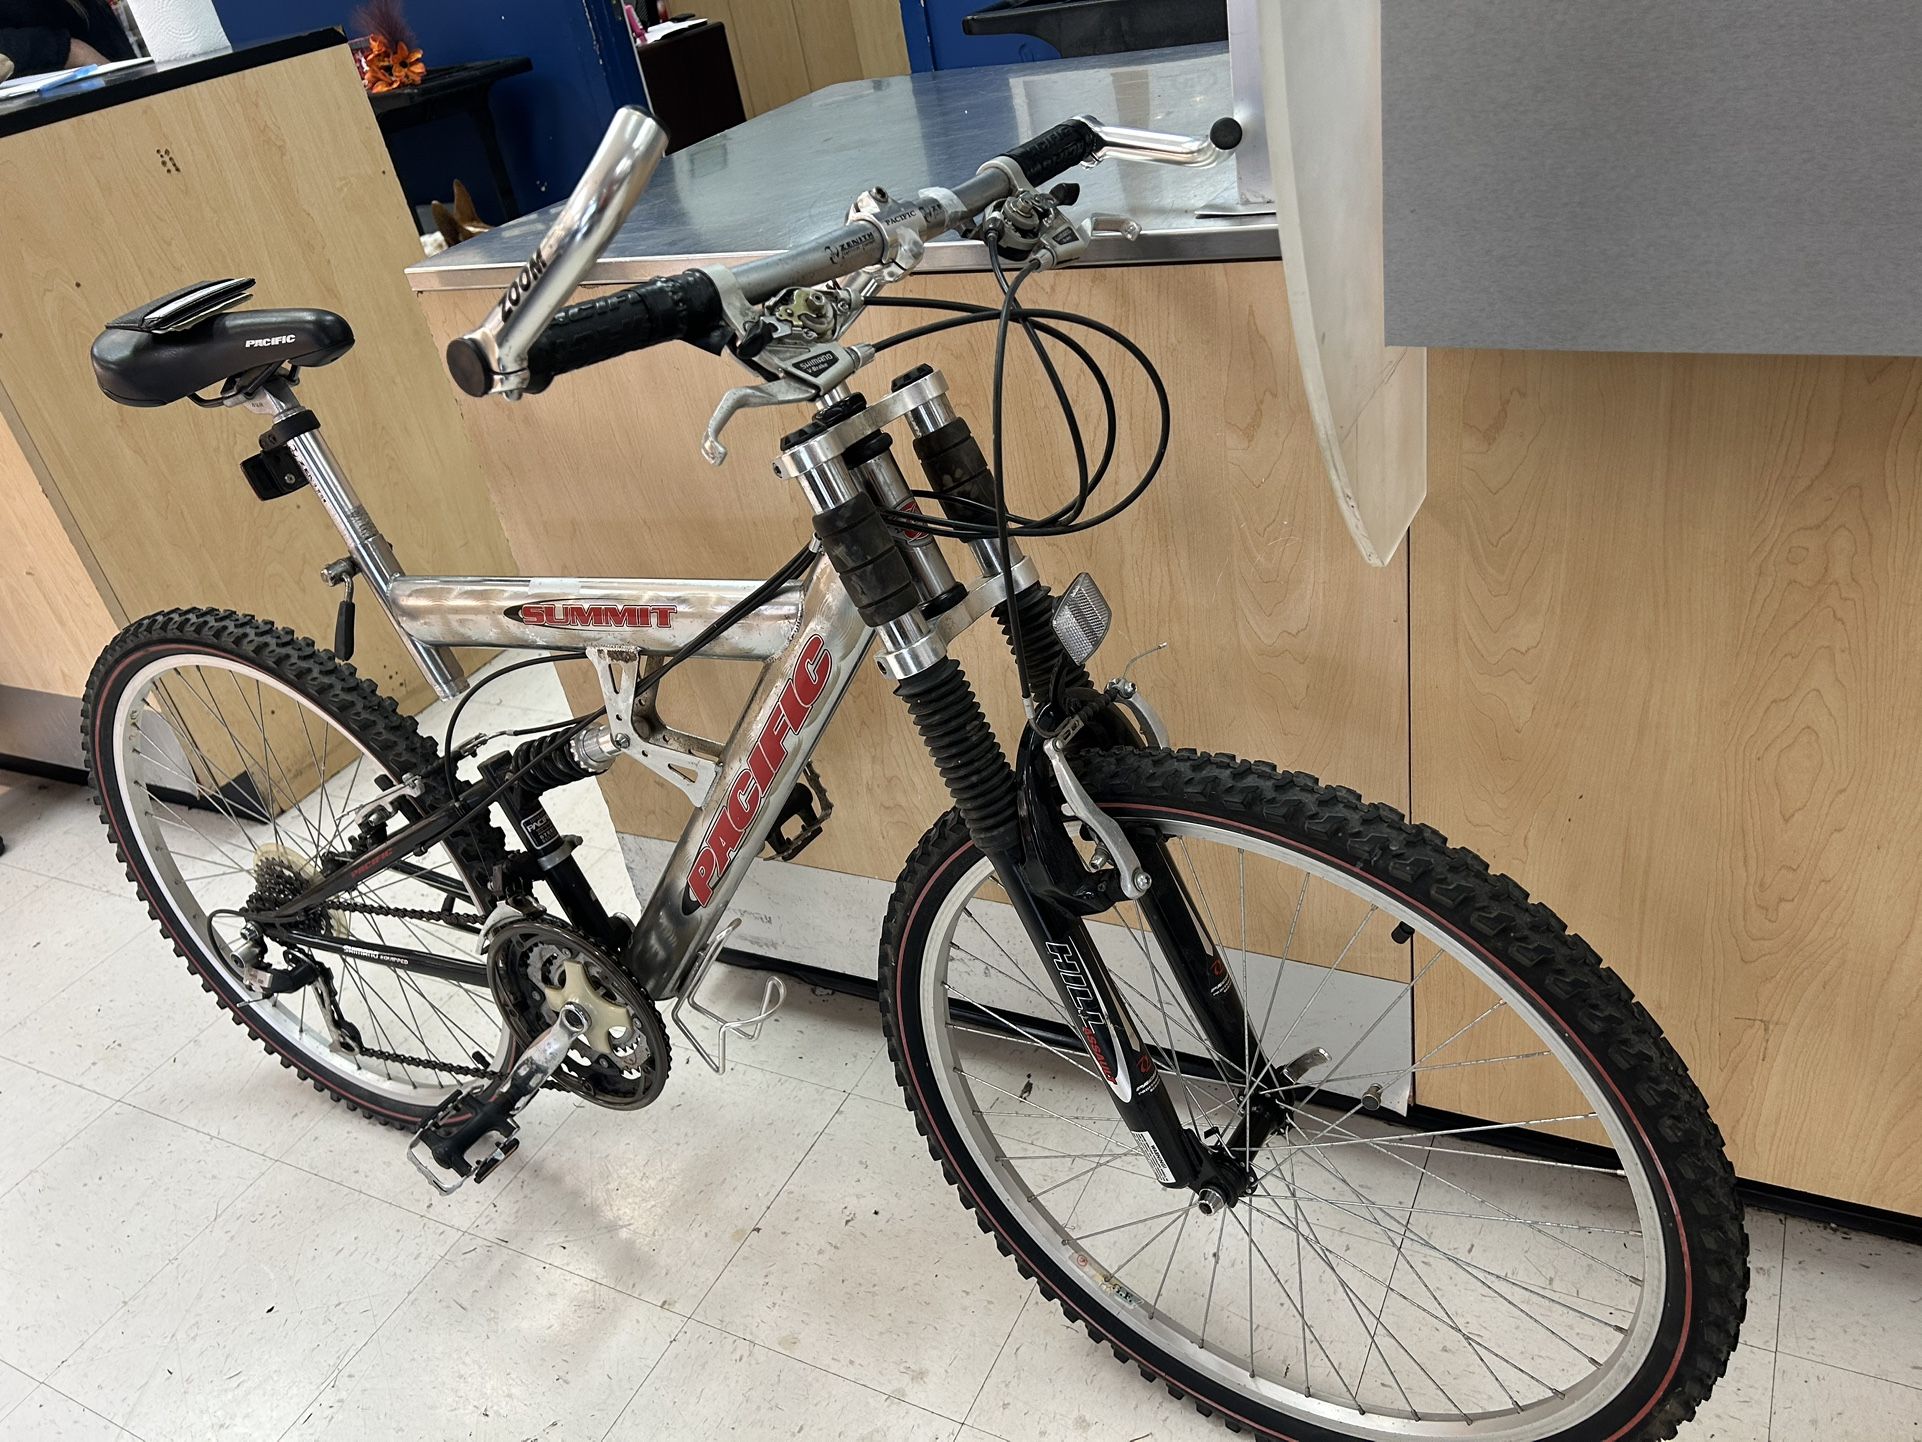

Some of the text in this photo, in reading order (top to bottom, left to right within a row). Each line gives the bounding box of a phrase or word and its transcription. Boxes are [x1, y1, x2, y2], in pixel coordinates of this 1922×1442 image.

[883, 208, 917, 227] PACIFIC
[840, 231, 875, 253] ZENITH
[498, 248, 547, 323] ZOOM
[245, 334, 296, 348] PACIFIC
[800, 353, 833, 370] SHIMANO
[521, 604, 678, 628] SUMMIT
[687, 633, 833, 908] PACIFIC
[343, 945, 379, 959] SHIMANO
[1045, 941, 1105, 1034] HILL
